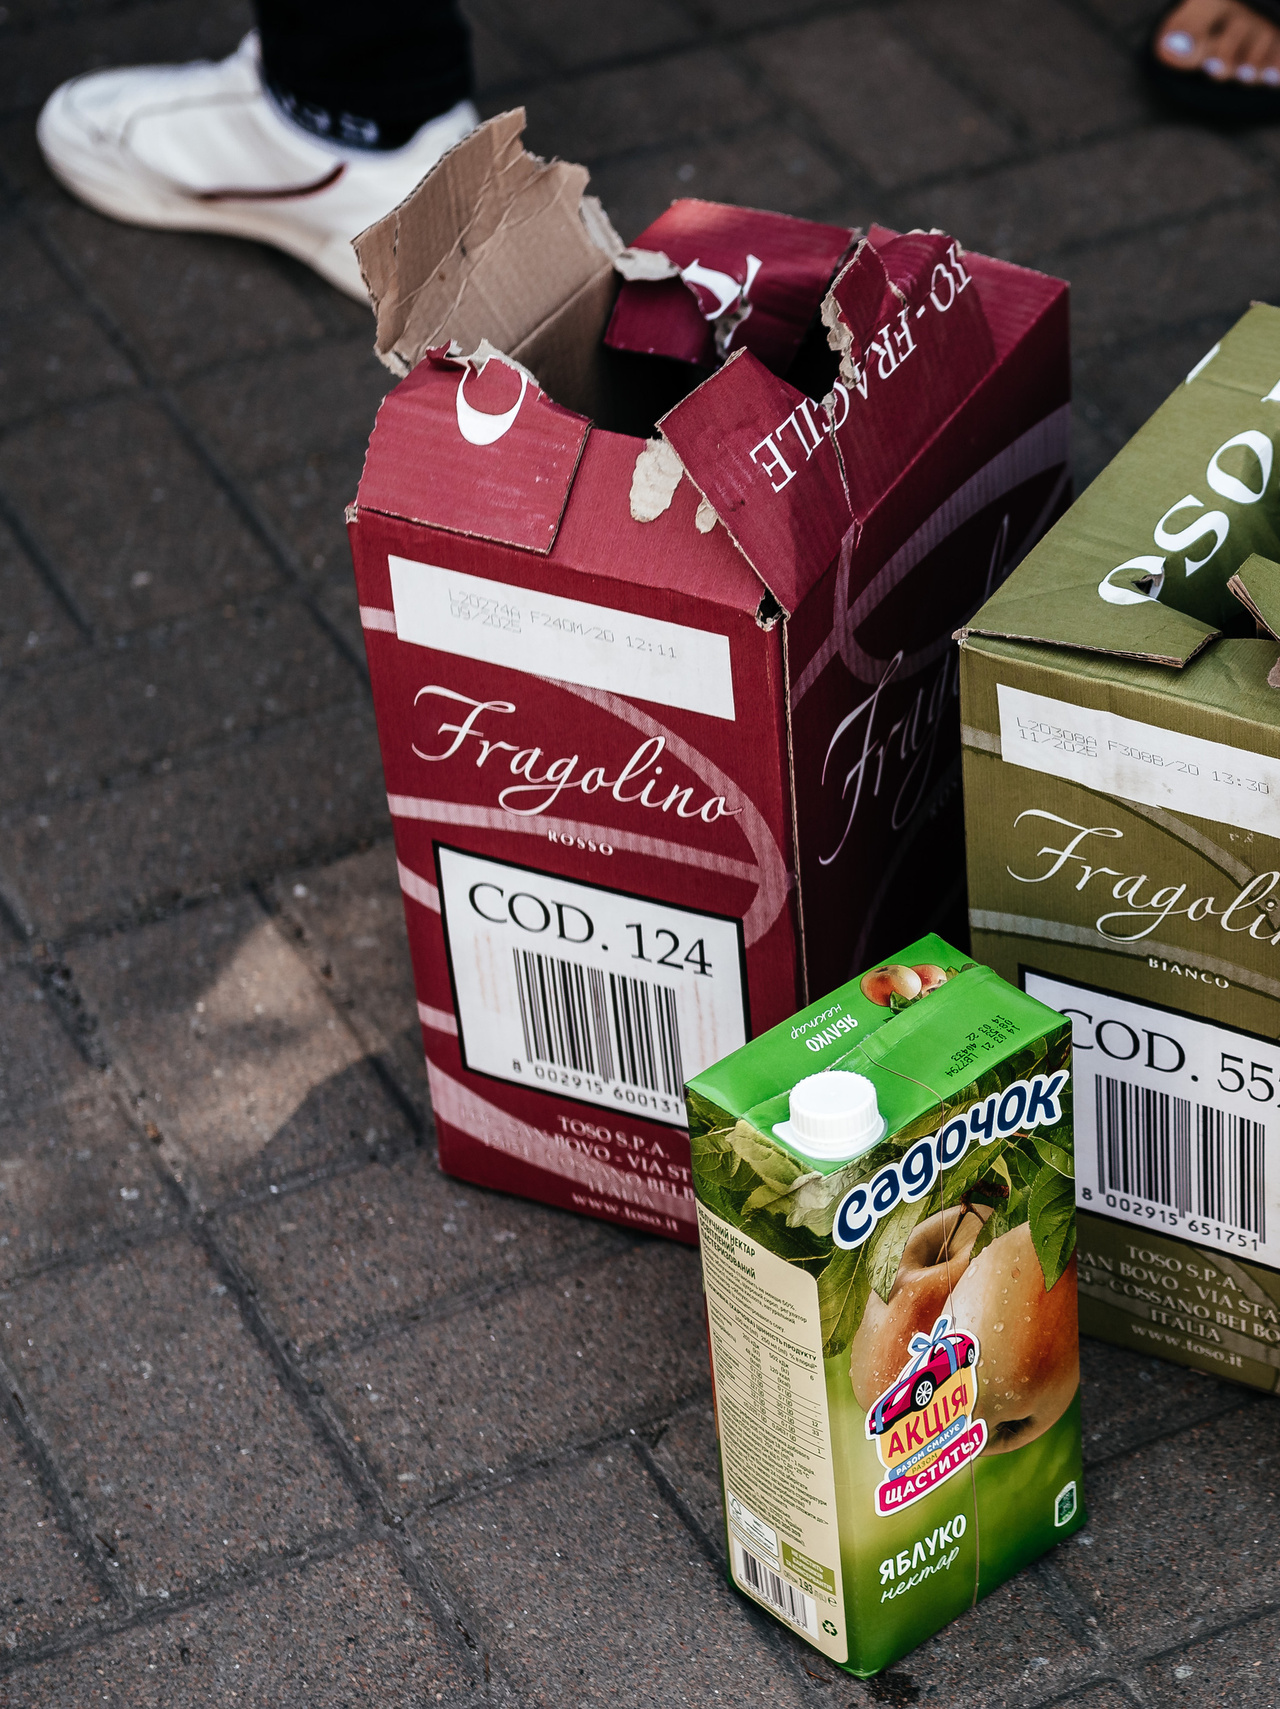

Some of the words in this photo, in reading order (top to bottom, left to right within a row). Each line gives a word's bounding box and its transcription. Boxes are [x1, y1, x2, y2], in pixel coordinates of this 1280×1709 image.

[626, 635, 678, 659] 12:11
[411, 685, 743, 823] Fragolino
[1016, 717, 1098, 747] L20308A
[1108, 741, 1200, 776] F308B/20
[1213, 771, 1269, 795] 13:30
[548, 829, 614, 857] ROSSO
[468, 882, 609, 952] COD.
[626, 922, 713, 978] 124
[1148, 957, 1229, 989] BIANCO
[790, 1003, 842, 1040] нектар
[805, 1014, 859, 1052] ЯБЛУКО
[965, 1032, 980, 1041] 22
[1006, 1025, 1020, 1035] 14
[981, 1042, 995, 1051] 21
[1058, 1008, 1199, 1082] COD.
[512, 1058, 522, 1074] 8
[534, 1064, 604, 1095] 002915
[613, 1085, 681, 1116] 600131
[553, 1132, 611, 1162] BOVO
[627, 1152, 663, 1176] VIA
[557, 1114, 612, 1144] TOSO
[615, 1130, 670, 1159] S.P.A.
[588, 1178, 655, 1209] ITALIA
[647, 1177, 694, 1201] BELB
[572, 1192, 678, 1232] www.toso.it
[1081, 1187, 1093, 1201] 8
[1106, 1194, 1178, 1226] 002915
[1188, 1220, 1258, 1252] 651751
[730, 1234, 756, 1257] НЕКТАР
[1120, 1261, 1178, 1290] BOVO
[1196, 1285, 1233, 1309] VIA
[1126, 1244, 1182, 1272] TOSO
[1186, 1264, 1242, 1292] S.P.A.
[1110, 1279, 1210, 1319] COSSANO
[1131, 1323, 1243, 1368] www.toso.it
[1151, 1308, 1221, 1343] ITALIA
[888, 1383, 968, 1459] АКЦІЯ
[885, 1432, 980, 1505] ЩАСТИТЬ!
[896, 1451, 924, 1476] РАЗОМ
[927, 1424, 960, 1452] СМАКУЄ
[911, 1453, 939, 1475] РАЗОМ
[879, 1514, 966, 1584] ЯБЛУКО
[881, 1546, 959, 1603] нектар
